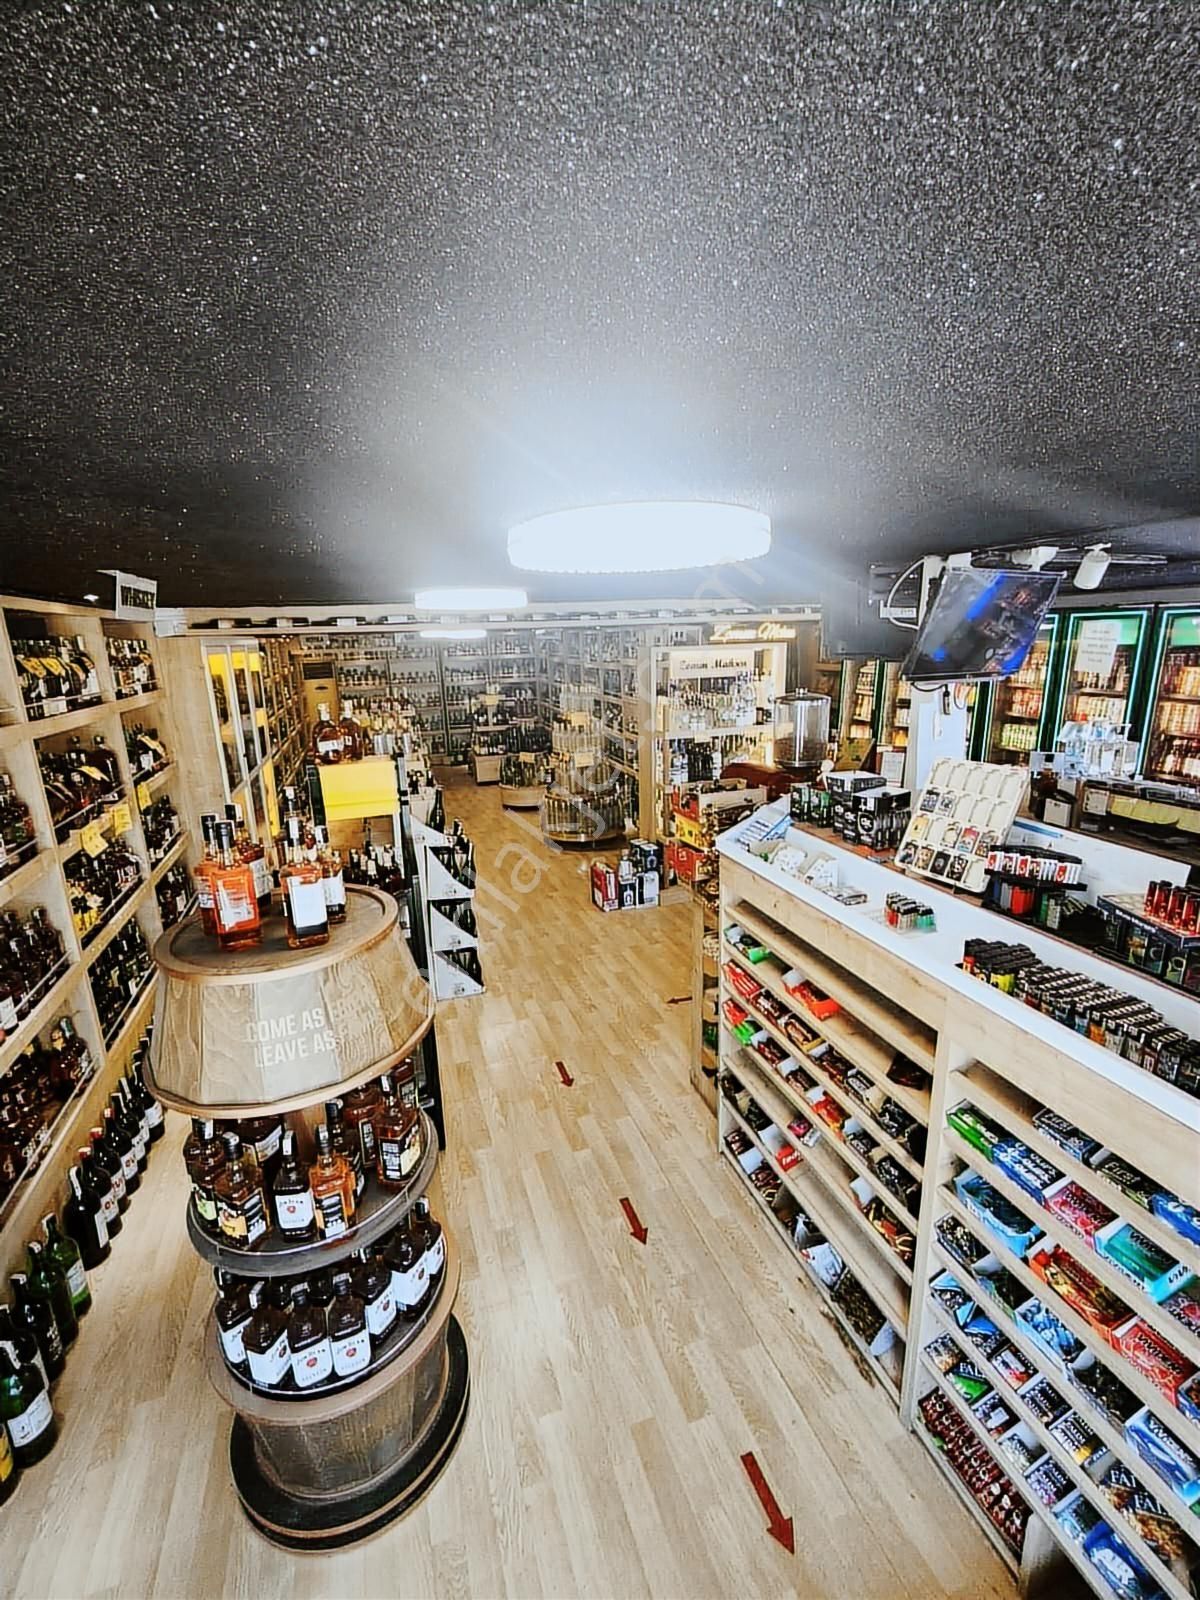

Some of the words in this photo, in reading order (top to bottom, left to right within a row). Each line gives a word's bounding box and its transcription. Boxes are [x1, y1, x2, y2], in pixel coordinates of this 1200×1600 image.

[246, 1014, 297, 1043] COME
[302, 1007, 326, 1032] AS
[254, 1036, 310, 1068] LEAVE
[313, 1029, 338, 1054] AS
[1103, 1161, 1142, 1184] First
[1136, 1332, 1185, 1375] VIVIDENT
